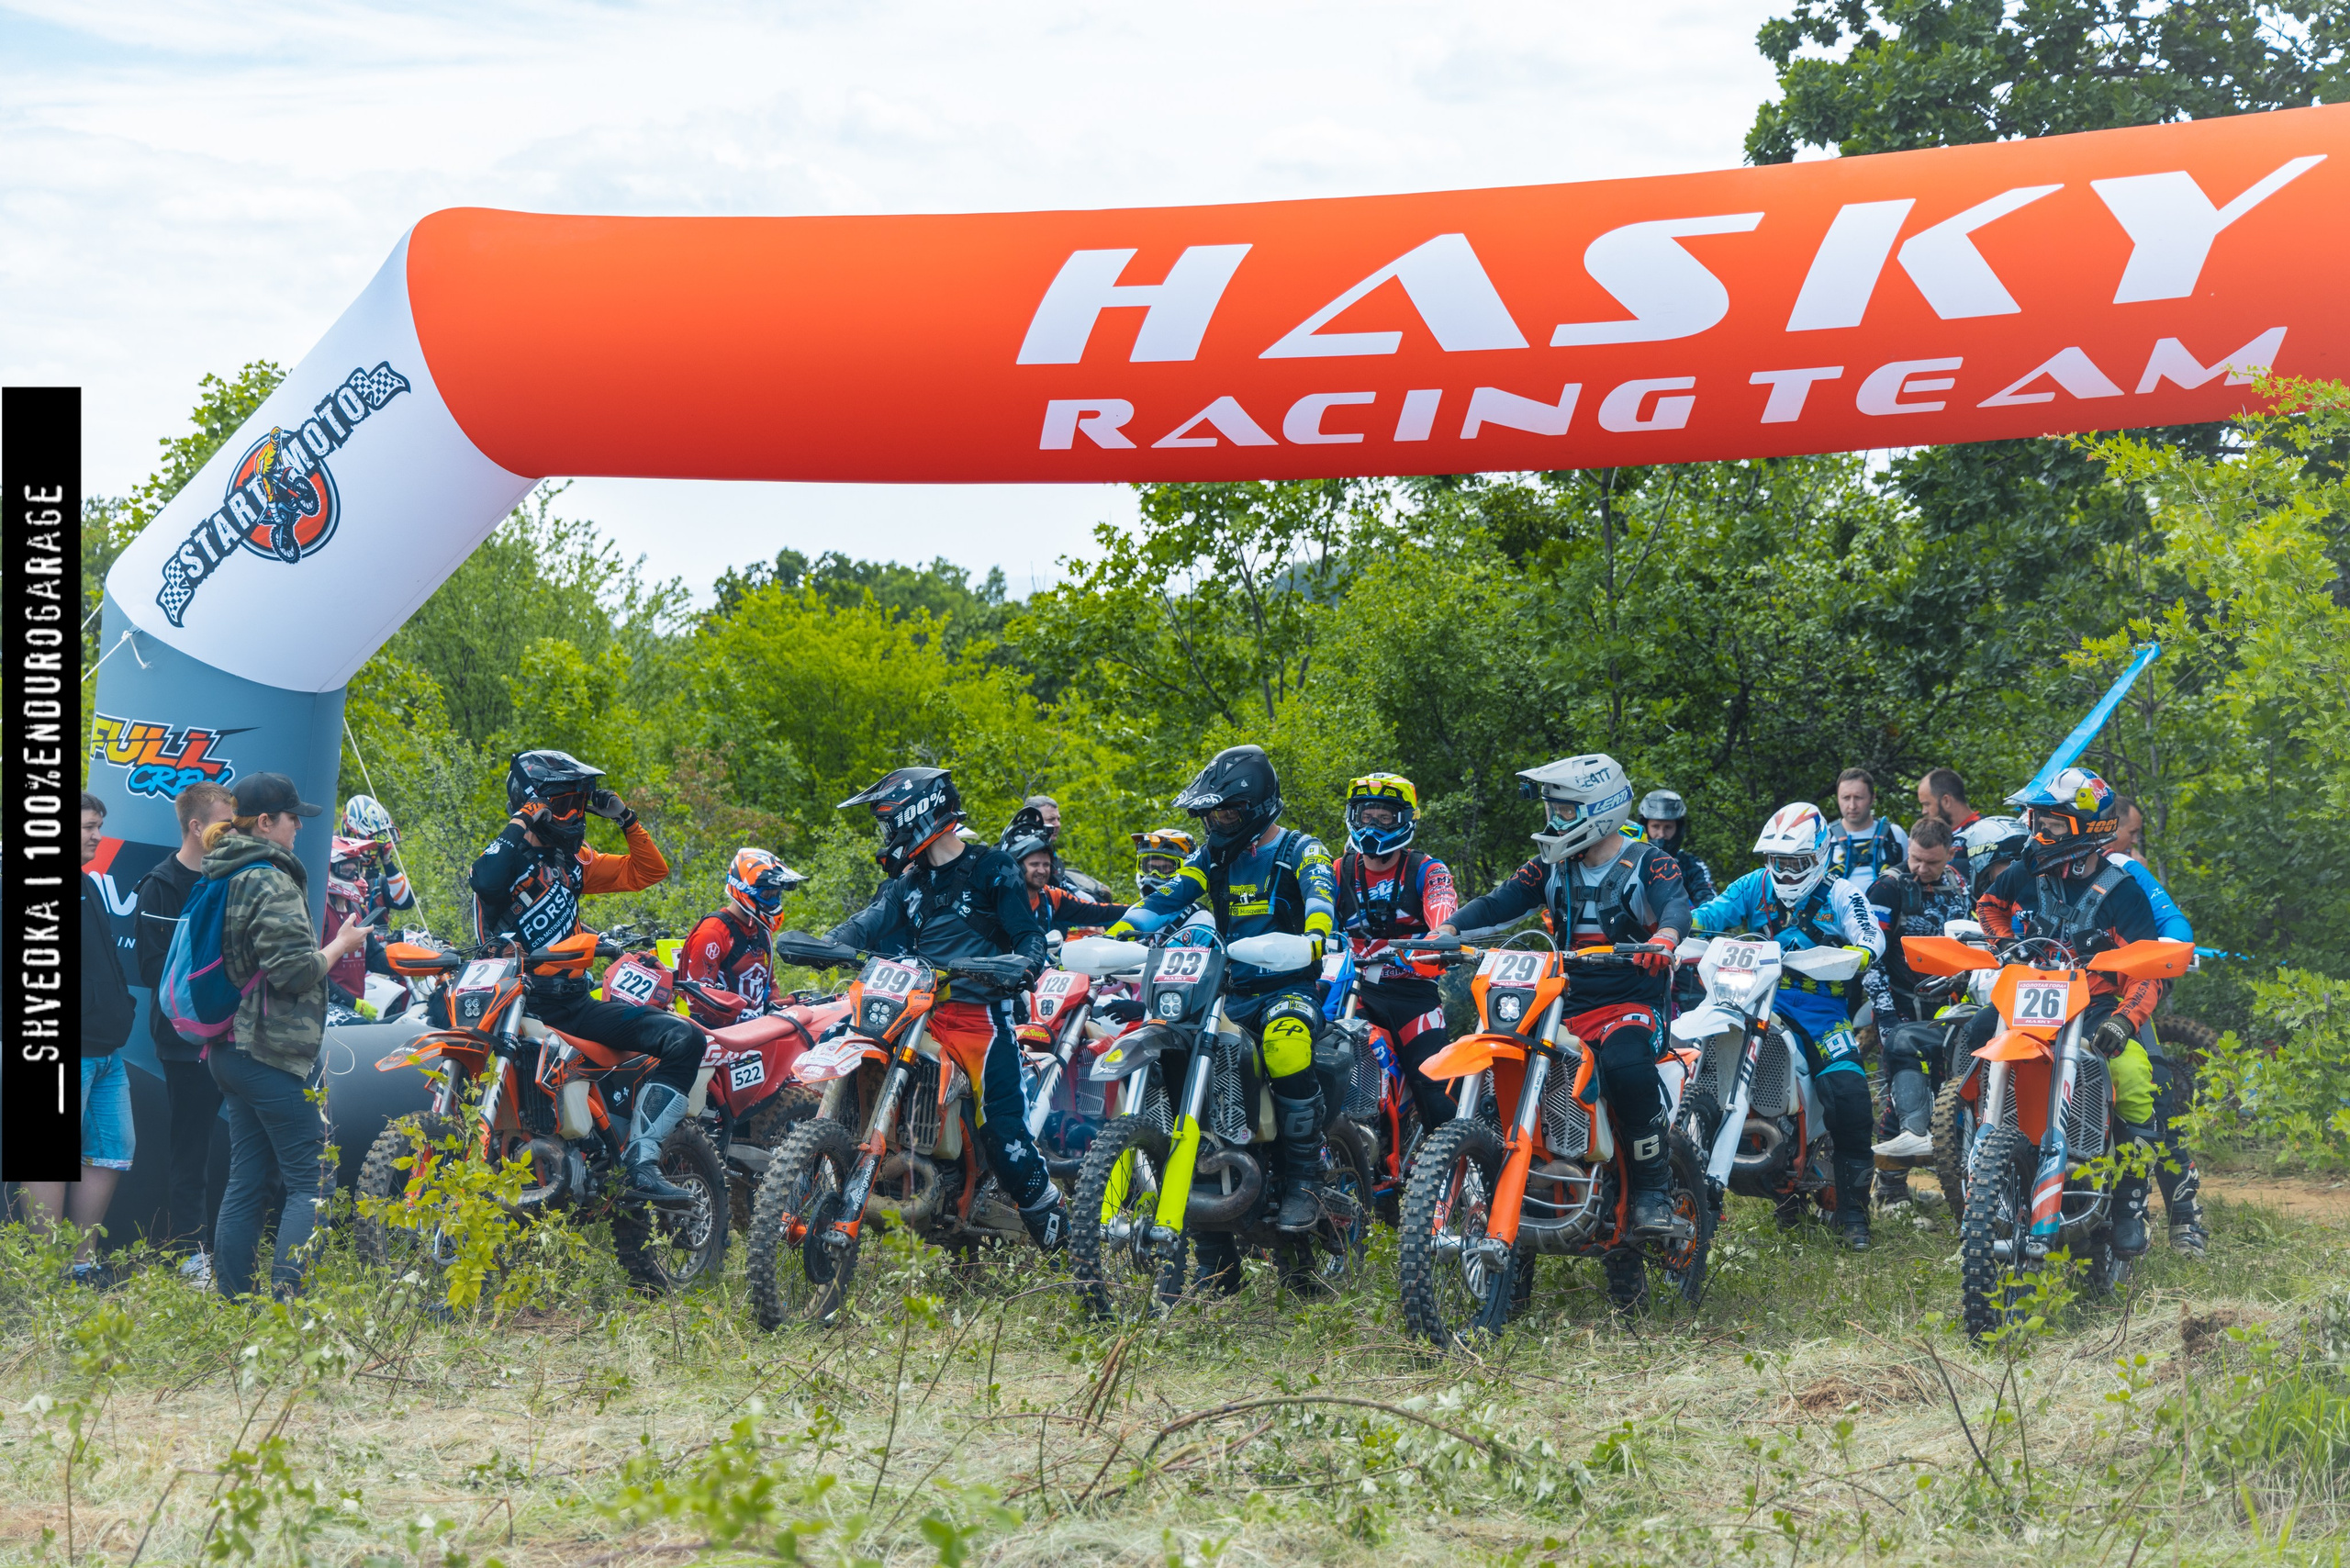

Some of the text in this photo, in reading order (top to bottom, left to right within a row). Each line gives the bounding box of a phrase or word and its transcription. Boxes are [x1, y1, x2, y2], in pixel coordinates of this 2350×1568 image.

[1015, 153, 2327, 365] HASKY
[1038, 325, 2288, 452] RACING TEAM
[179, 386, 365, 579] START MOTO
[91, 716, 223, 776] FULL
[129, 765, 231, 797] CRE
[1574, 767, 1611, 789] LEATT
[894, 790, 946, 828] 100%
[1592, 790, 1628, 814] LEATT
[727, 874, 757, 896] 100%
[532, 935, 544, 948] СЕТЬ
[1163, 951, 1203, 976] 93
[1496, 954, 1538, 981] 29
[1721, 946, 1756, 969] 36
[468, 963, 491, 986] 2
[616, 970, 653, 1001] 222
[871, 966, 912, 993] 99
[1042, 976, 1071, 993] 128
[2021, 988, 2061, 1019] 26
[734, 1065, 762, 1087] 522
[853, 1159, 876, 1211] erzbergrodeo
[1043, 1212, 1060, 1249] SIDI
